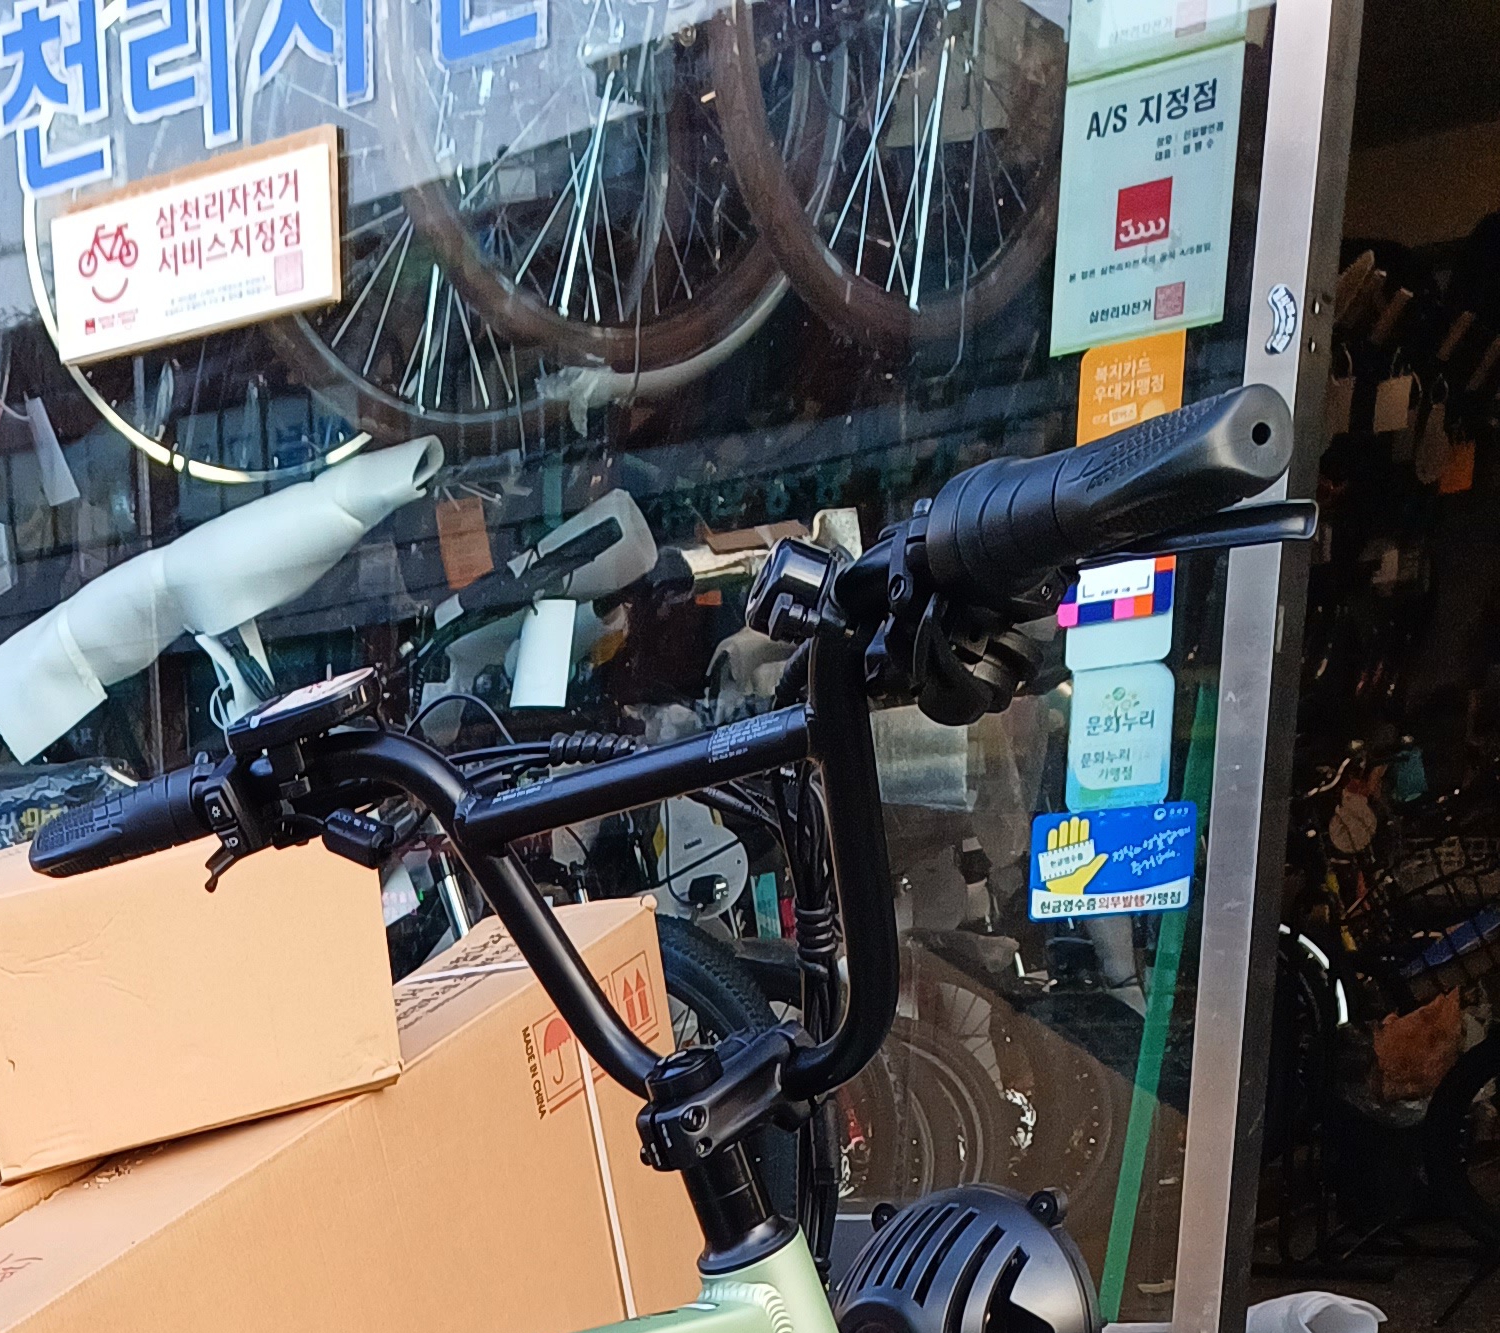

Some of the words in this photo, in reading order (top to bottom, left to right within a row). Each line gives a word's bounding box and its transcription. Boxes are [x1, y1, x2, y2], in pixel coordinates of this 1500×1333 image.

[1087, 104, 1127, 140] A/S
[1138, 78, 1217, 126] 지정점
[156, 169, 298, 239] 삼천리자전거
[158, 211, 300, 276] 서비스지정점
[1089, 298, 1152, 324] 삼천리자전거
[1086, 706, 1155, 737] 문화누리
[1081, 748, 1130, 769] 문화누리
[522, 1026, 535, 1063] MADE
[529, 1064, 538, 1078] IN
[533, 1079, 546, 1120] CHINA
